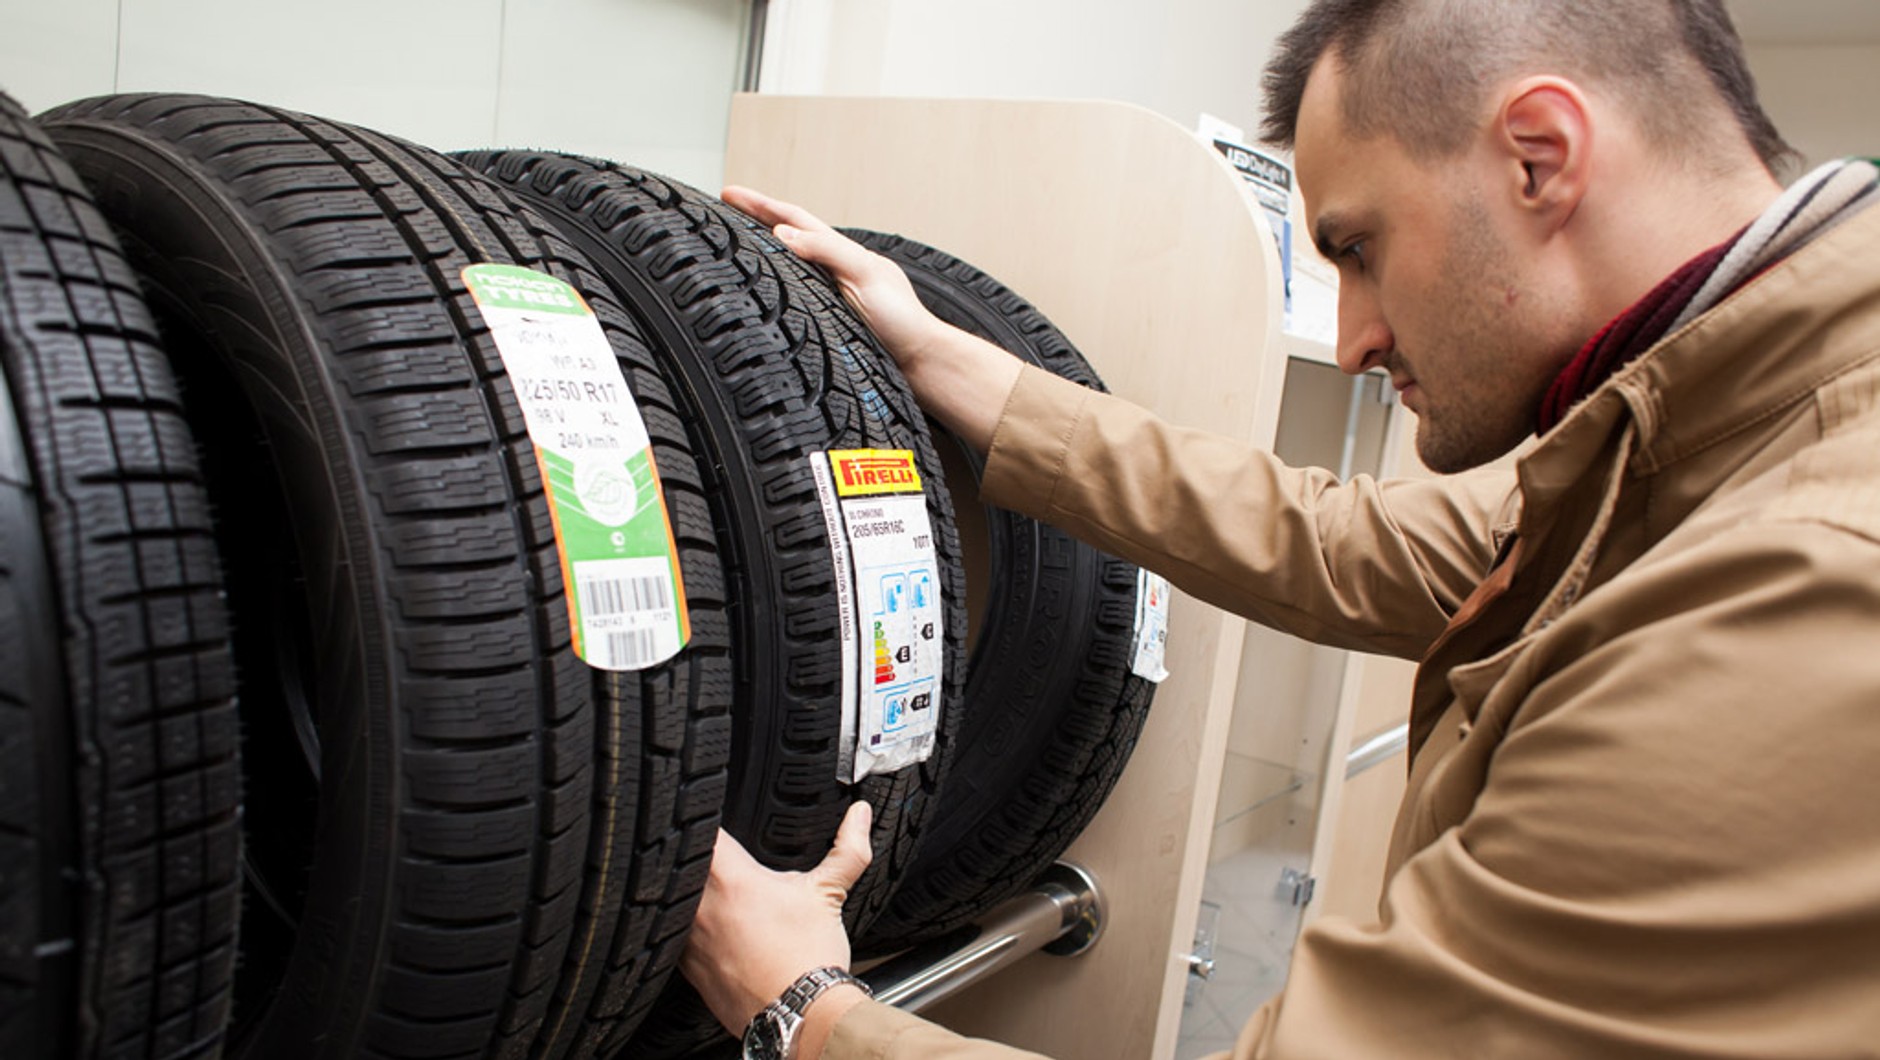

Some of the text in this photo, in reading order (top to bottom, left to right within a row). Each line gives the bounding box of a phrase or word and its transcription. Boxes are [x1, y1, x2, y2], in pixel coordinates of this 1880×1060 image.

[481, 285, 574, 308] TYRES
[582, 380, 619, 404] R17
[554, 408, 566, 424] V
[599, 410, 620, 427] XL
[558, 431, 583, 449] 240
[839, 458, 914, 486] PIRELLI
